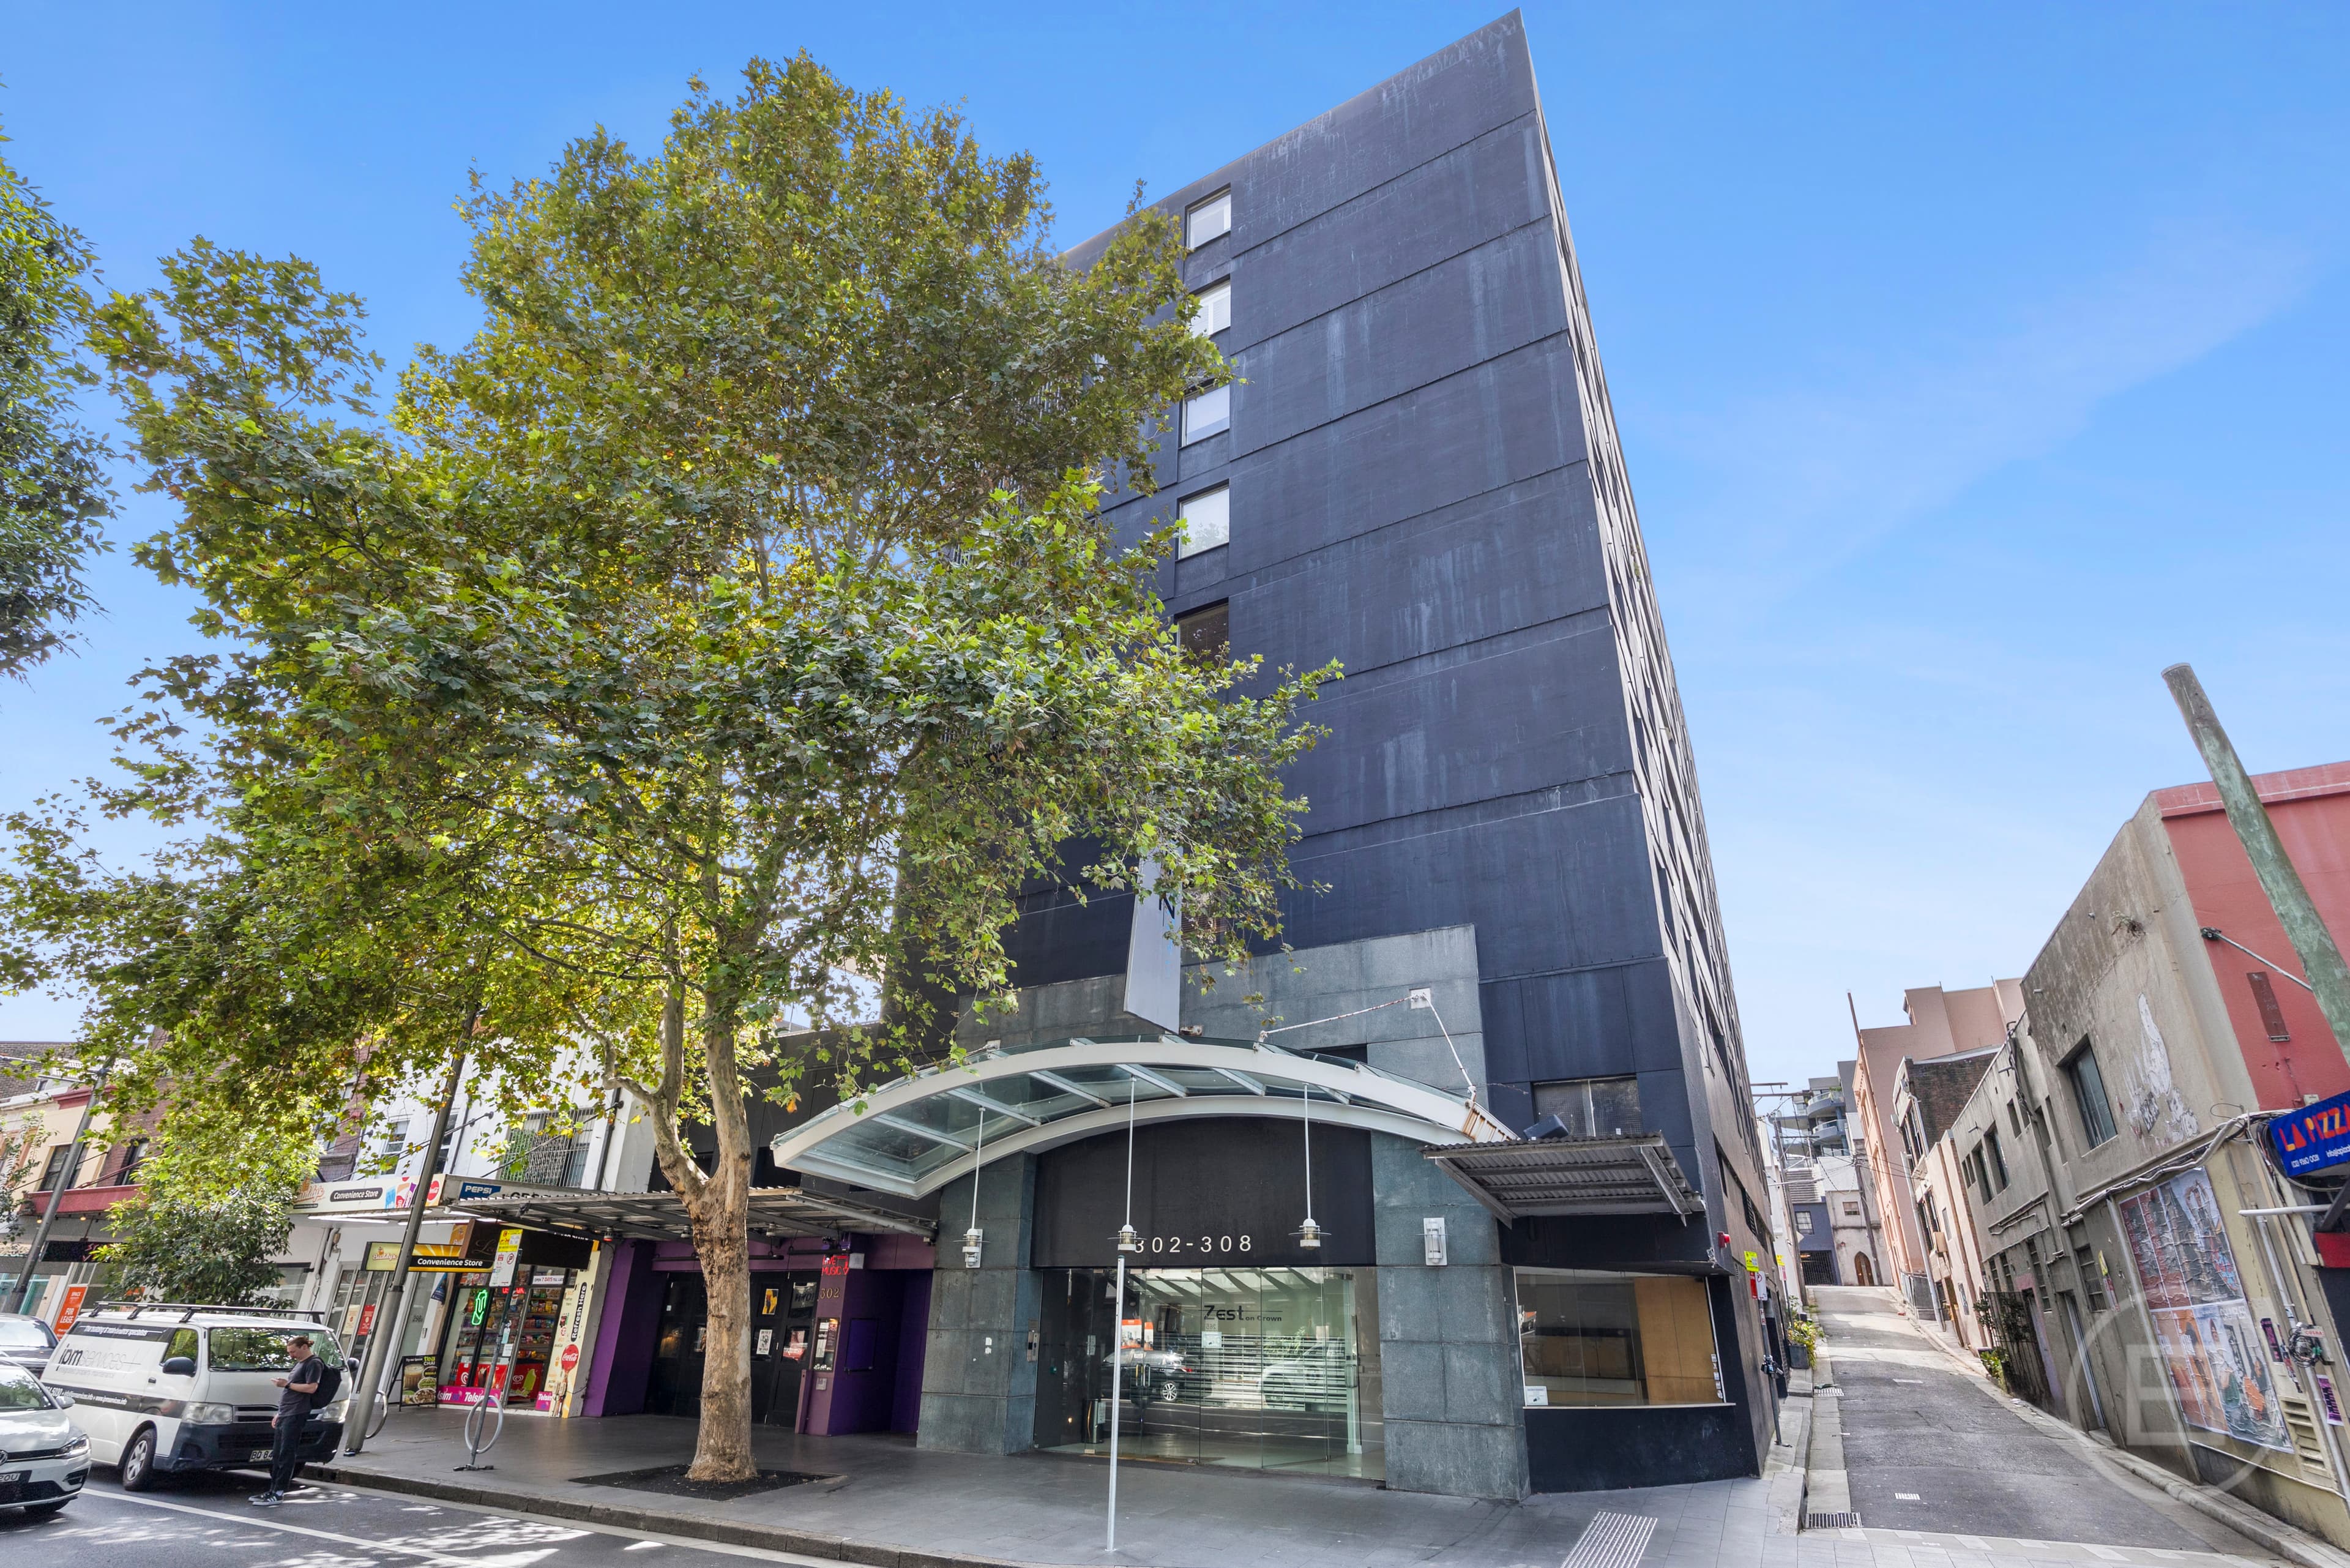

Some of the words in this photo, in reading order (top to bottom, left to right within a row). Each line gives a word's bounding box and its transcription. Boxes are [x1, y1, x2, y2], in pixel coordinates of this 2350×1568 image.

[2278, 1123, 2307, 1151] LA
[334, 1191, 365, 1200] Convenience
[465, 1185, 492, 1194] PEPSI
[1135, 1235, 1251, 1253] 302-308
[820, 1287, 840, 1299] 302
[572, 1307, 583, 1338] Refresh
[578, 1286, 586, 1305] Here
[1204, 1305, 1244, 1321] Zest
